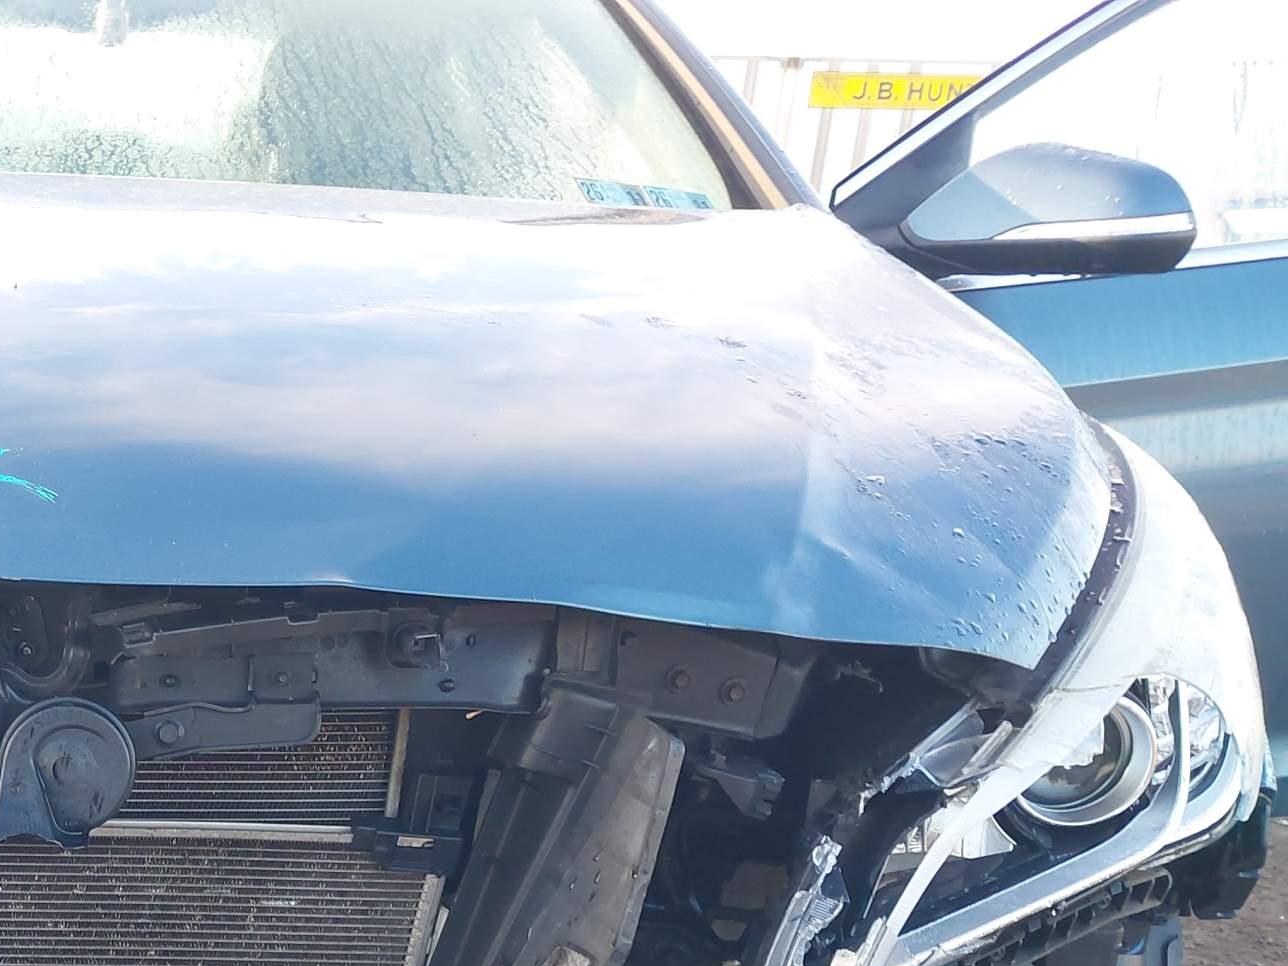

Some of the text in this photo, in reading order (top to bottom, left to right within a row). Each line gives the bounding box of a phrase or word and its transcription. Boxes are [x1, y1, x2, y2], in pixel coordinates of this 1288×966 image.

[852, 81, 972, 102] J.B. HUN
[580, 181, 606, 202] 26
